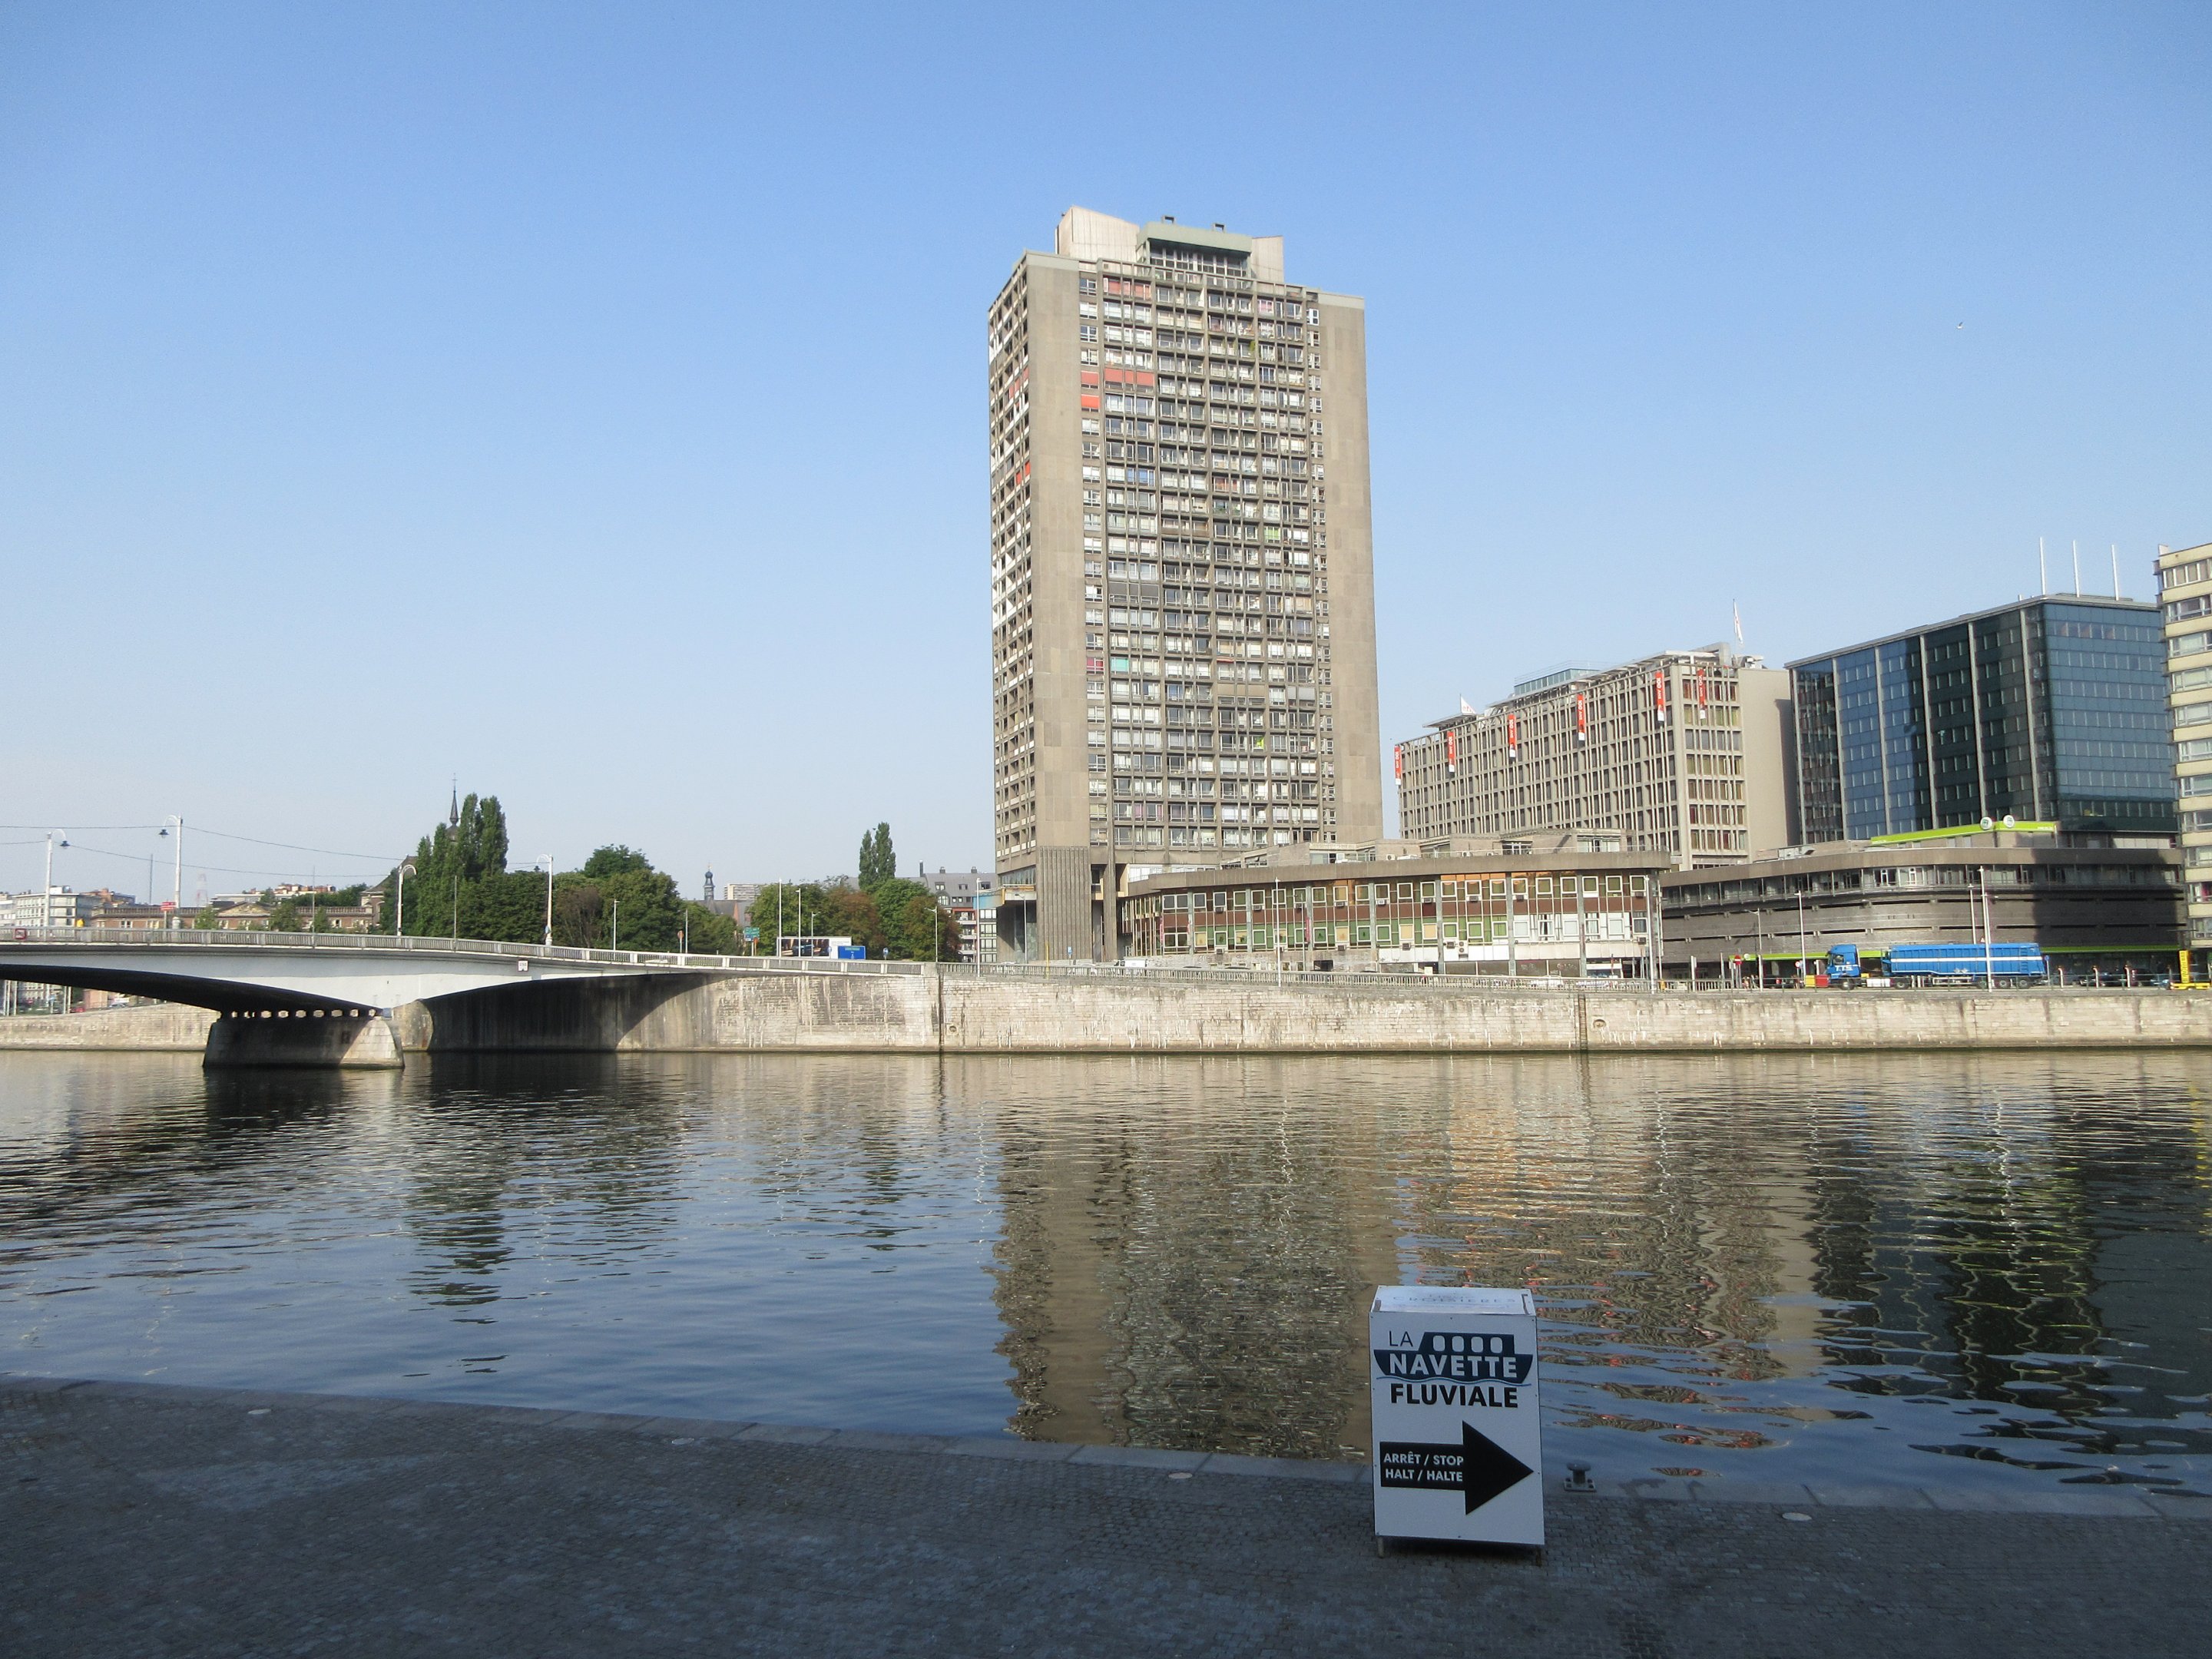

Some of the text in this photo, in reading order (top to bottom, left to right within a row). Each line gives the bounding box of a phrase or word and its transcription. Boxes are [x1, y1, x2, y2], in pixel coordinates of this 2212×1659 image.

[1389, 1330, 1413, 1348] LA
[1389, 1353, 1518, 1378] NAVETTE
[1390, 1383, 1518, 1408] FLUVIALE
[1384, 1451, 1421, 1464] ARRÊT
[1433, 1455, 1463, 1465] STOP
[1386, 1469, 1415, 1479] HALT
[1426, 1470, 1463, 1482] HALTE
